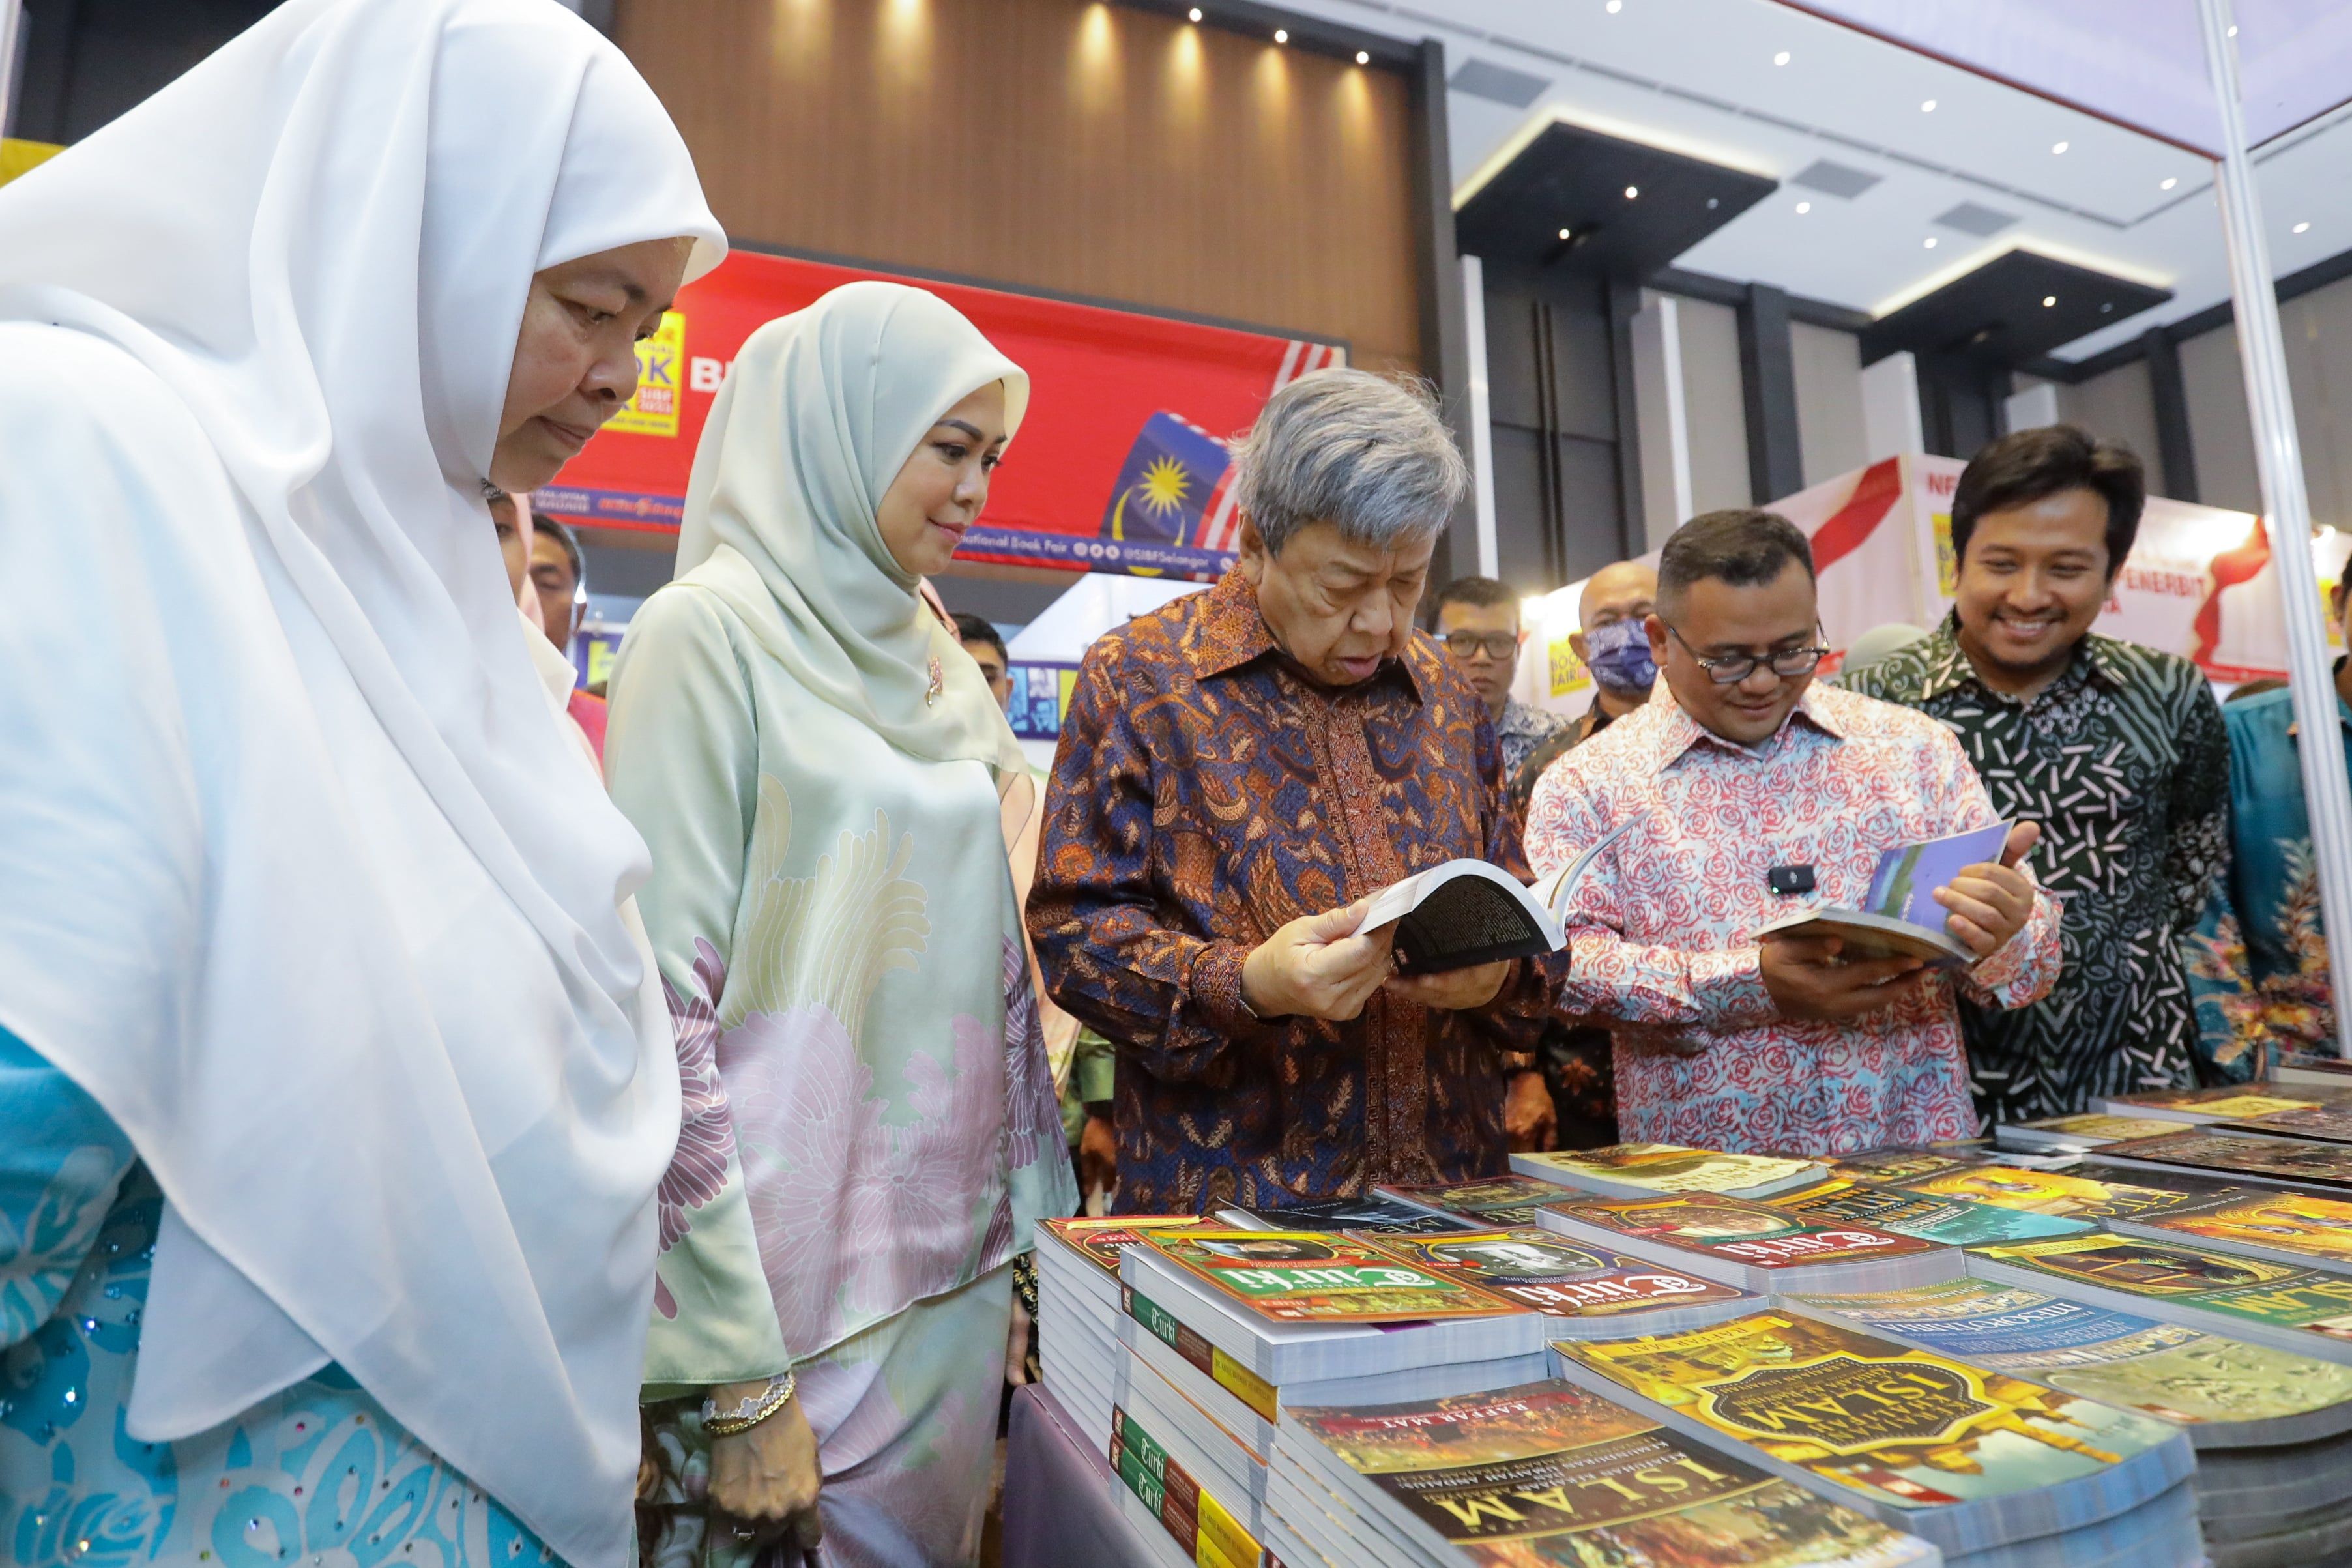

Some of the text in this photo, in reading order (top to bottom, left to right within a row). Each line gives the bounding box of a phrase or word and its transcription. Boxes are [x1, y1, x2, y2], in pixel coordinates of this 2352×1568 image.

[1011, 536, 1041, 551] Book
[1044, 540, 1067, 553] Fair
[1715, 1232, 1895, 1259] Turki
[1222, 1268, 1436, 1292] Turki
[1503, 1275, 1707, 1308] Turki
[1902, 1283, 1990, 1302] MUHAMMAD
[2258, 1281, 2303, 1291] ALAM
[1582, 1292, 1654, 1304] SEJARAH
[2188, 1289, 2256, 1302] MELAYU
[1151, 1305, 1175, 1345] Turki
[1872, 1302, 2083, 1332] MESOPOTAMIA
[1625, 1327, 1749, 1352] RAFFAR MAT
[1436, 1402, 1532, 1422] RAFFAR
[1737, 1372, 1953, 1430] ISLAM
[1805, 1392, 1952, 1433] KHALIFAH
[1380, 1417, 1432, 1428] MAT
[1824, 1400, 1973, 1442] KERAJAAN
[1140, 1435, 1165, 1481] Turki
[1482, 1464, 1561, 1482] UMAIYAH
[1513, 1473, 1599, 1492] KERAJAAN
[1137, 1470, 1161, 1518] Turki
[1432, 1457, 1728, 1527] ISLAM
